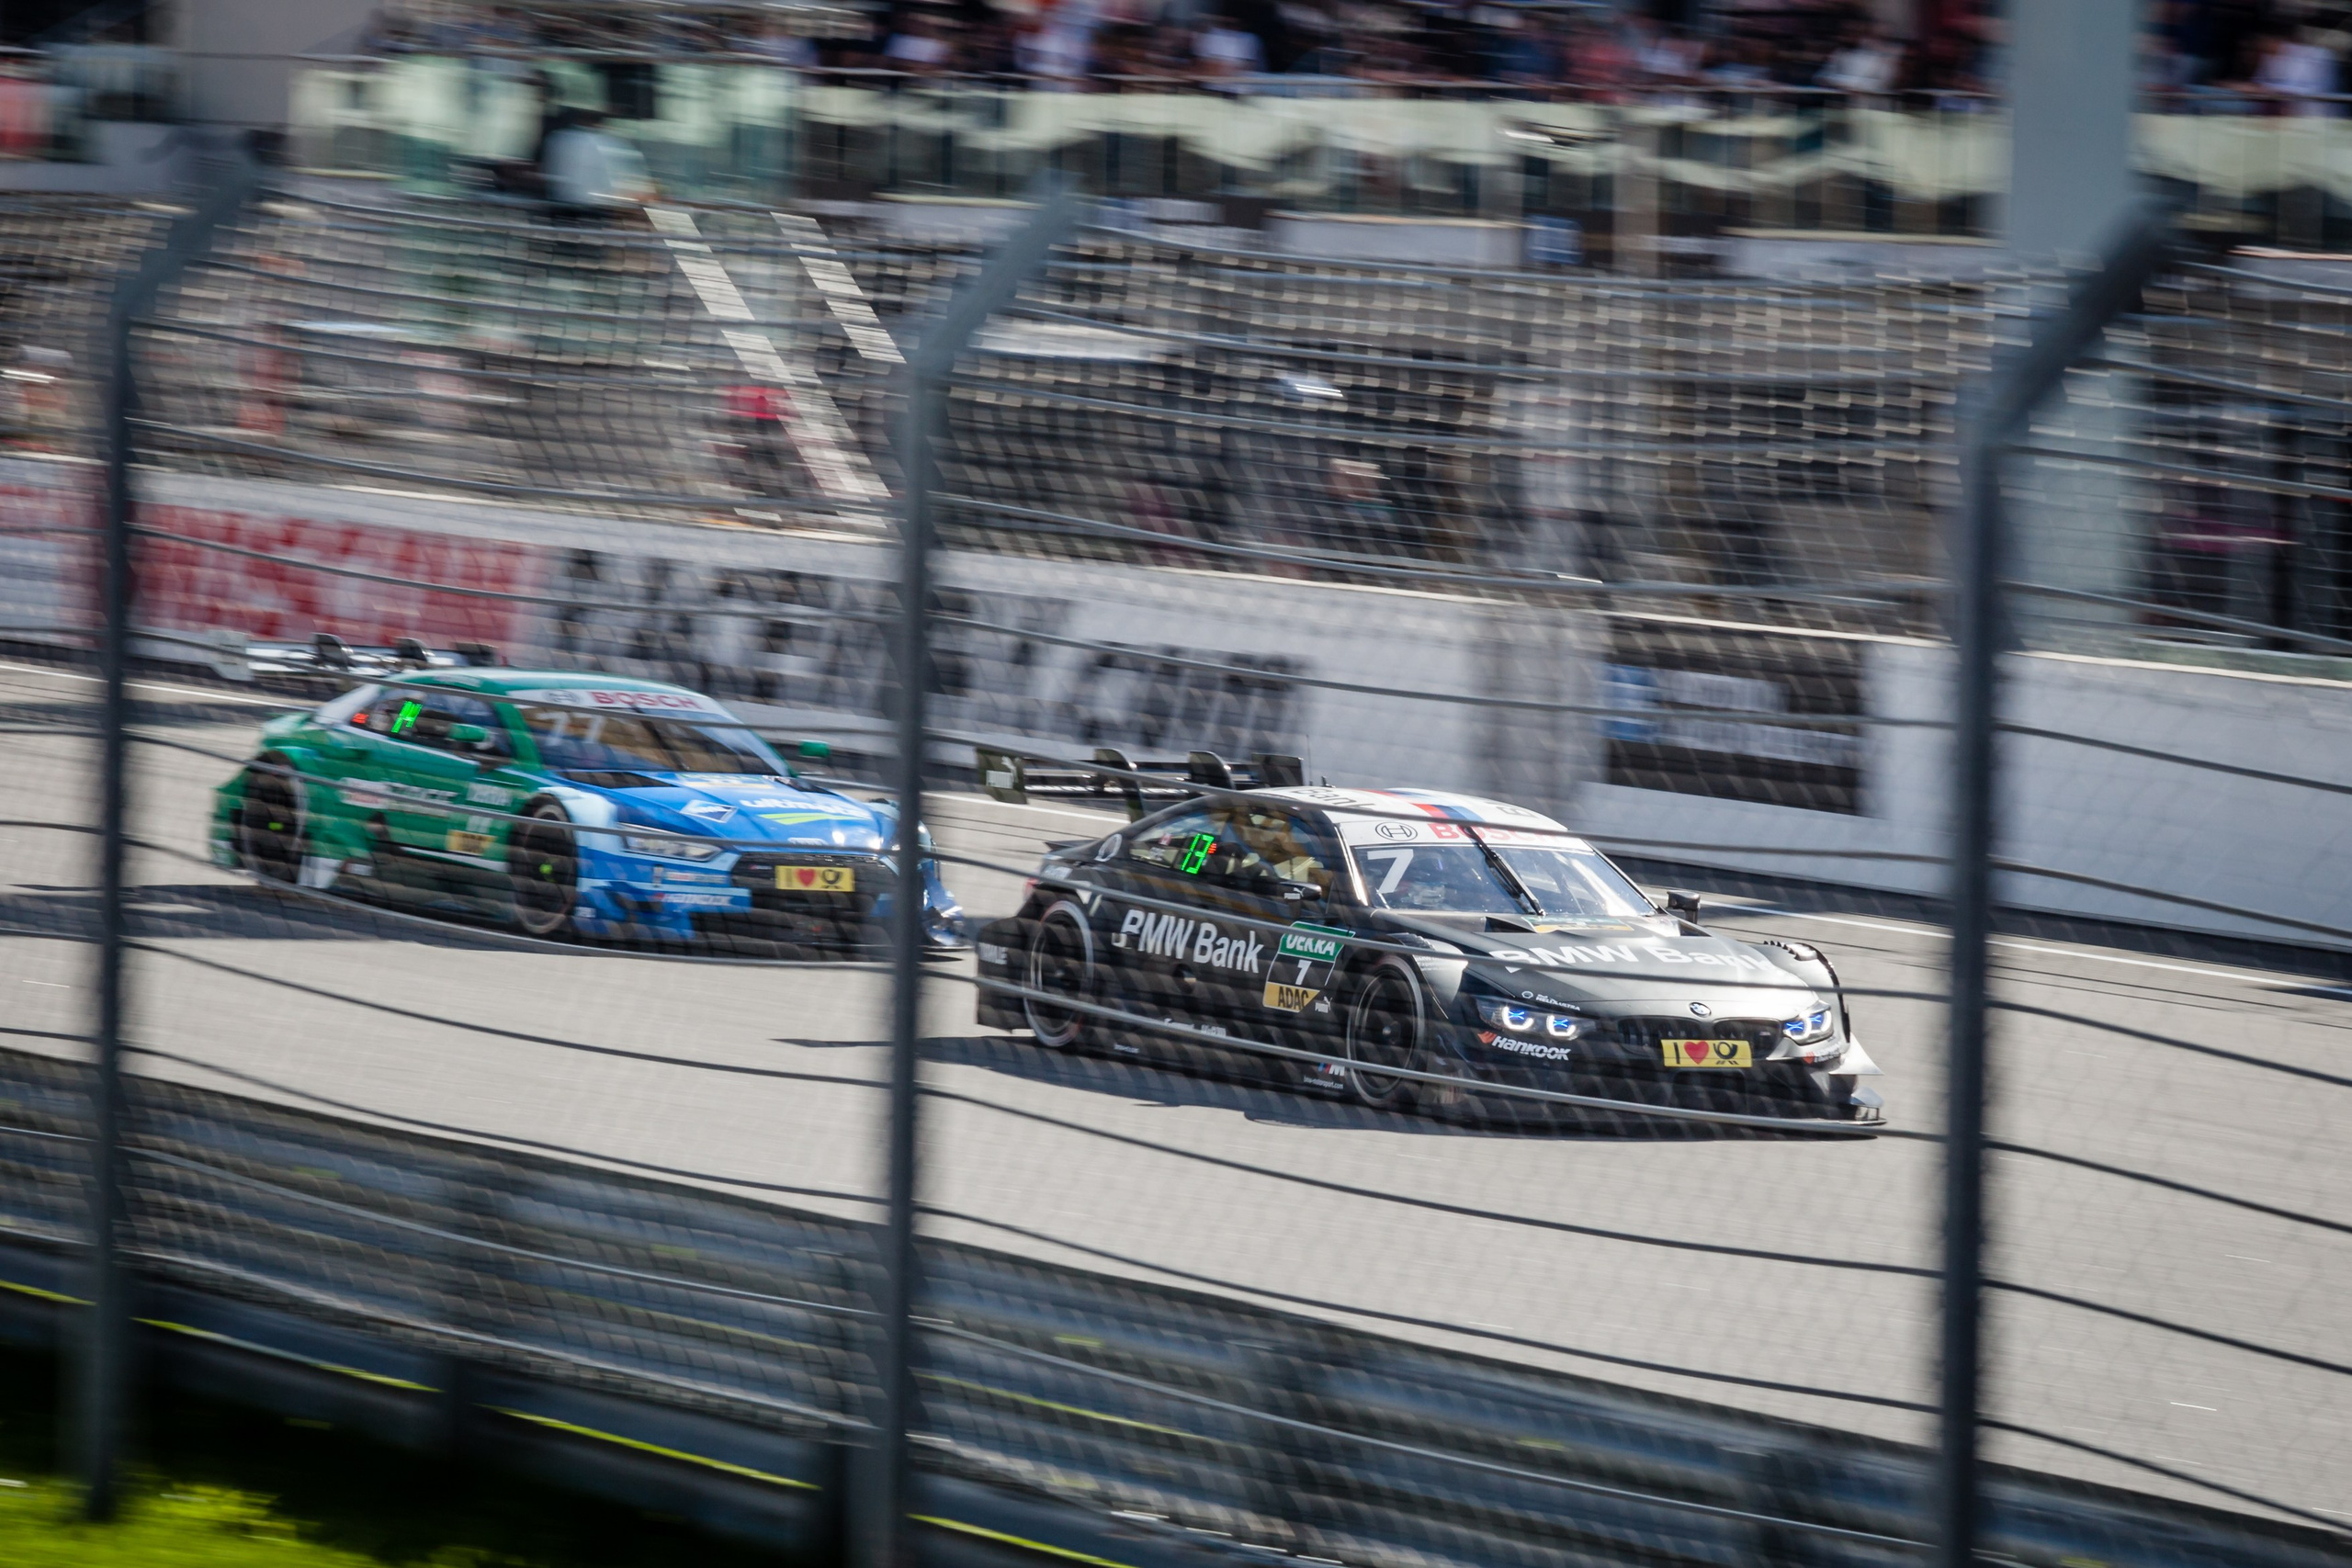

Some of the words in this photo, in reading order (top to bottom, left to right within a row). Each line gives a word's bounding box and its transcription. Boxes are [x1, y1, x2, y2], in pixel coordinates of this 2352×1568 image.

[588, 691, 704, 710] BOSCH
[1367, 849, 1415, 895] 7
[1114, 909, 1195, 959] BMW
[1193, 922, 1265, 974] Bank
[1295, 959, 1312, 986] 7
[1489, 945, 1639, 973] BMW
[1278, 986, 1309, 1010] ADAC
